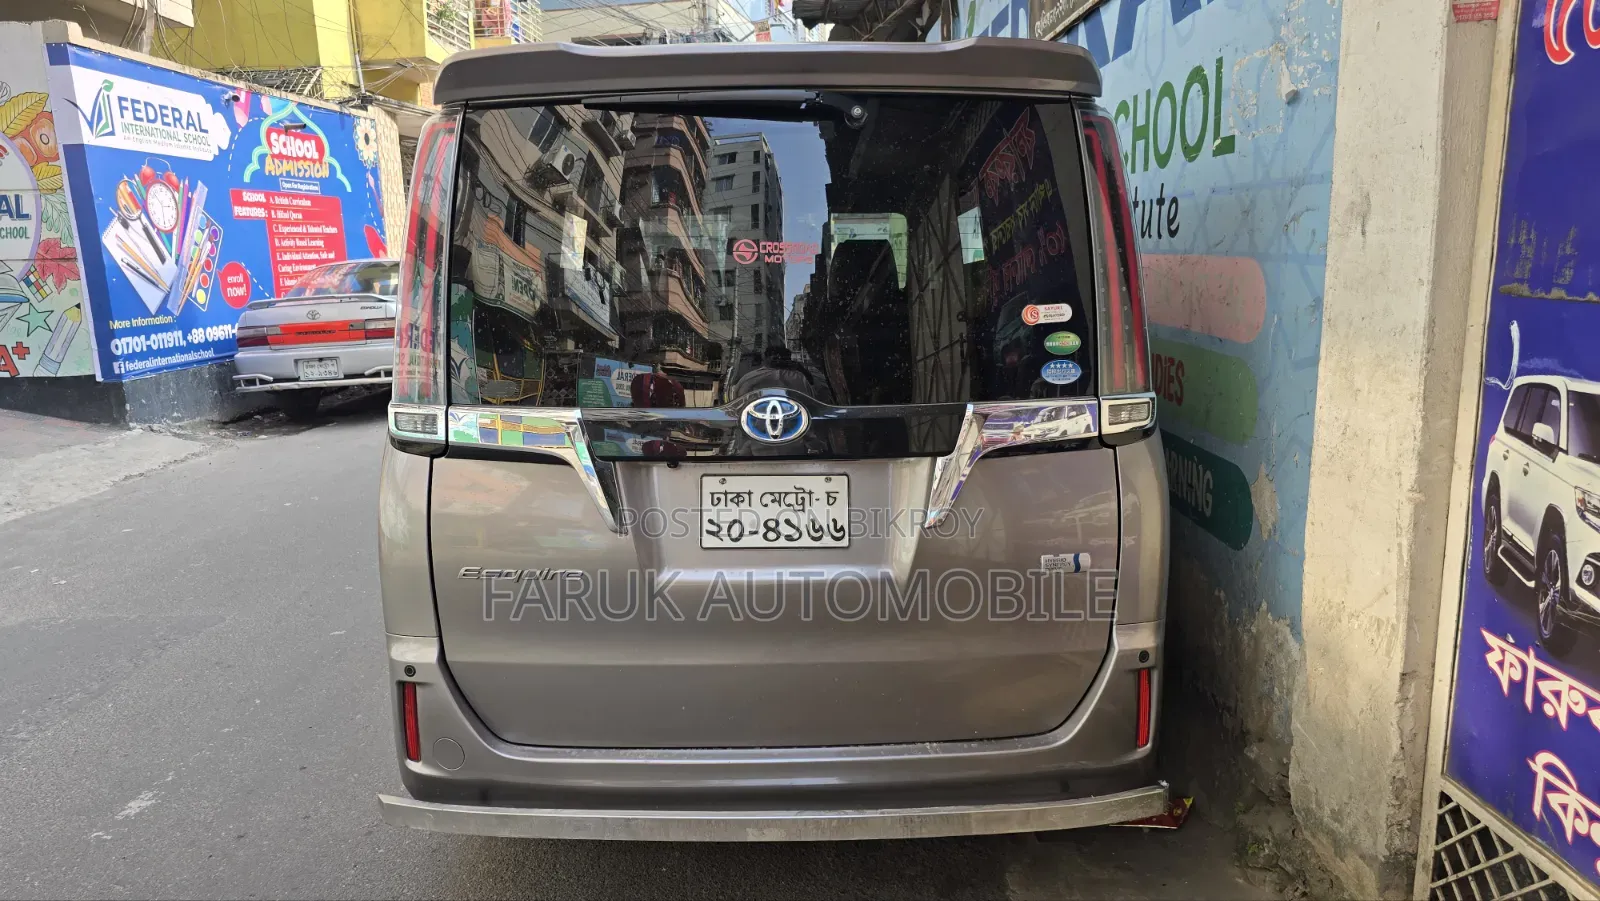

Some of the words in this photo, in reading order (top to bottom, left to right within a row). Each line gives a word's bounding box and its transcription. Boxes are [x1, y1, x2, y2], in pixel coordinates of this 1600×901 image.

[117, 95, 209, 134] FEDERAL
[1114, 56, 1235, 174] CHOOL
[121, 122, 182, 142] INTERNATIONAL
[183, 132, 211, 147] SCHOOL
[270, 131, 319, 160] SCHOOL
[264, 153, 330, 179] ADMISSION
[0, 194, 30, 219] AL
[242, 191, 266, 203] SCHOOL
[1132, 183, 1180, 240] tute
[0, 226, 30, 239] CHOOL
[227, 273, 244, 284] enroll
[109, 319, 131, 330] More
[132, 315, 173, 328] Information
[110, 329, 187, 356] 01701-011911,
[187, 327, 206, 345] +88
[125, 348, 215, 372] federalinternationalschool
[1151, 353, 1185, 407] DIES
[1165, 447, 1214, 518] RNING
[709, 489, 754, 507] ঢাকা
[825, 491, 840, 506] চ
[705, 517, 846, 543] ২০-৪১৬৬
[457, 566, 584, 583] Esquire
[1480, 628, 1600, 732] ফারু
